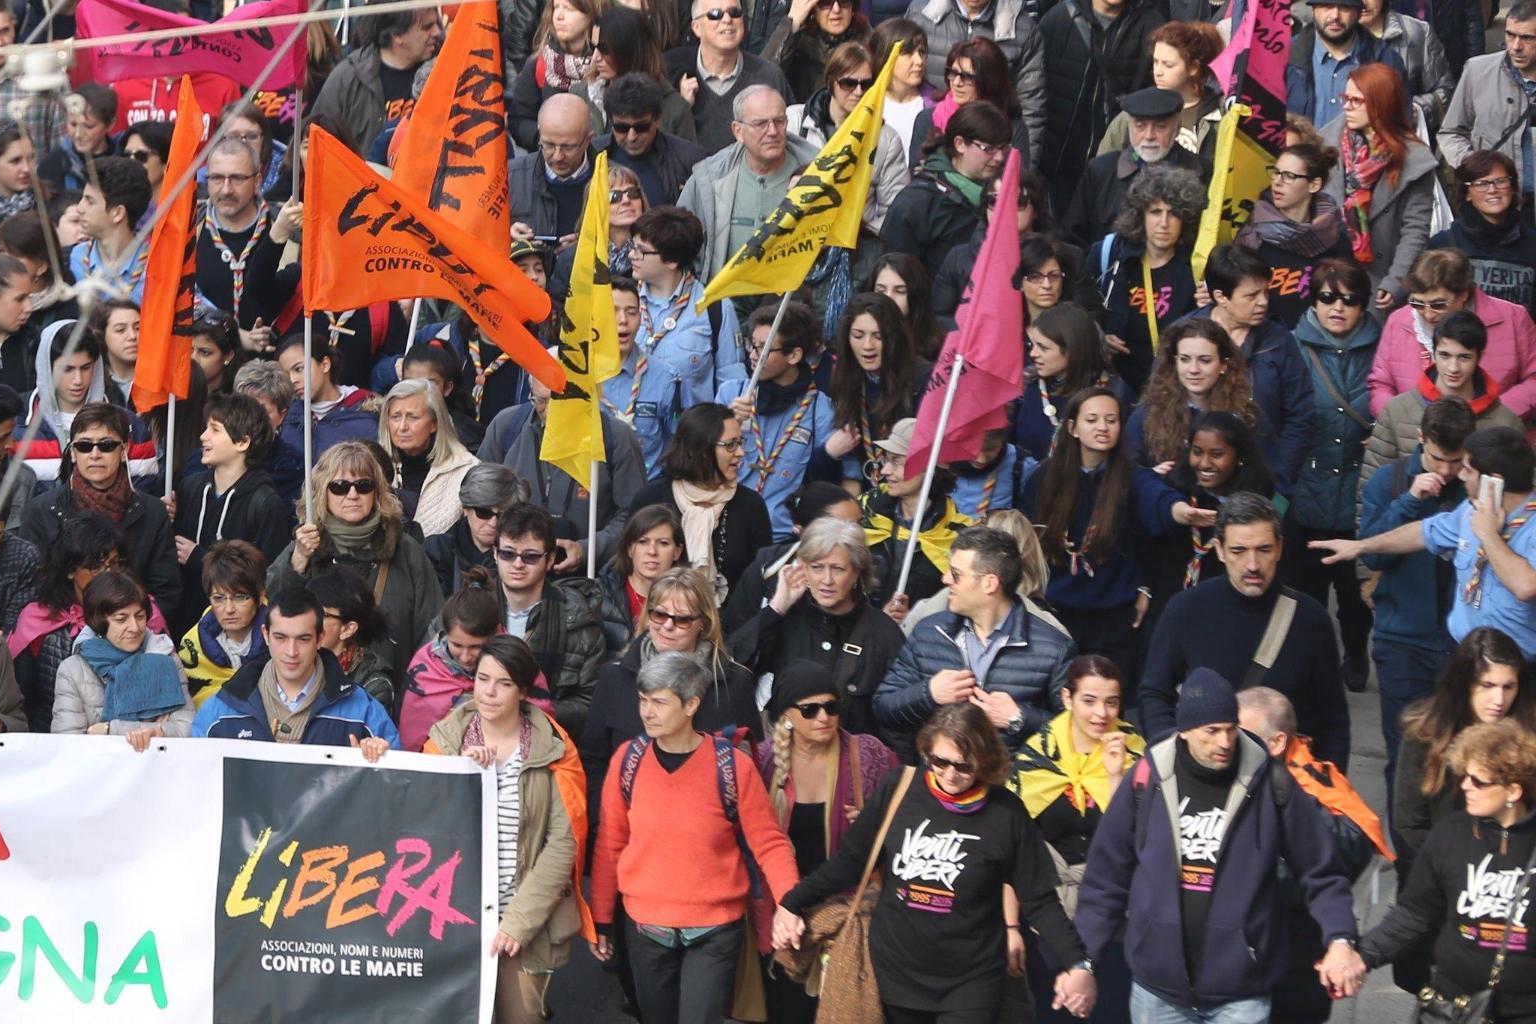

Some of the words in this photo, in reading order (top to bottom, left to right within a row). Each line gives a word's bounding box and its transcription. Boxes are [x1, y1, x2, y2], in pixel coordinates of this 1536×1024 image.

[364, 256, 435, 274] CONTRO
[901, 818, 982, 865] Venti
[1466, 852, 1536, 903] Vent
[260, 939, 338, 958] ASSOCIAZIONI,
[339, 943, 370, 958] NOMI
[371, 945, 379, 958] E
[381, 946, 424, 961] NUMERI
[260, 954, 336, 975] CONTRO
[340, 958, 362, 976] LE
[365, 960, 424, 977] MAFIE
